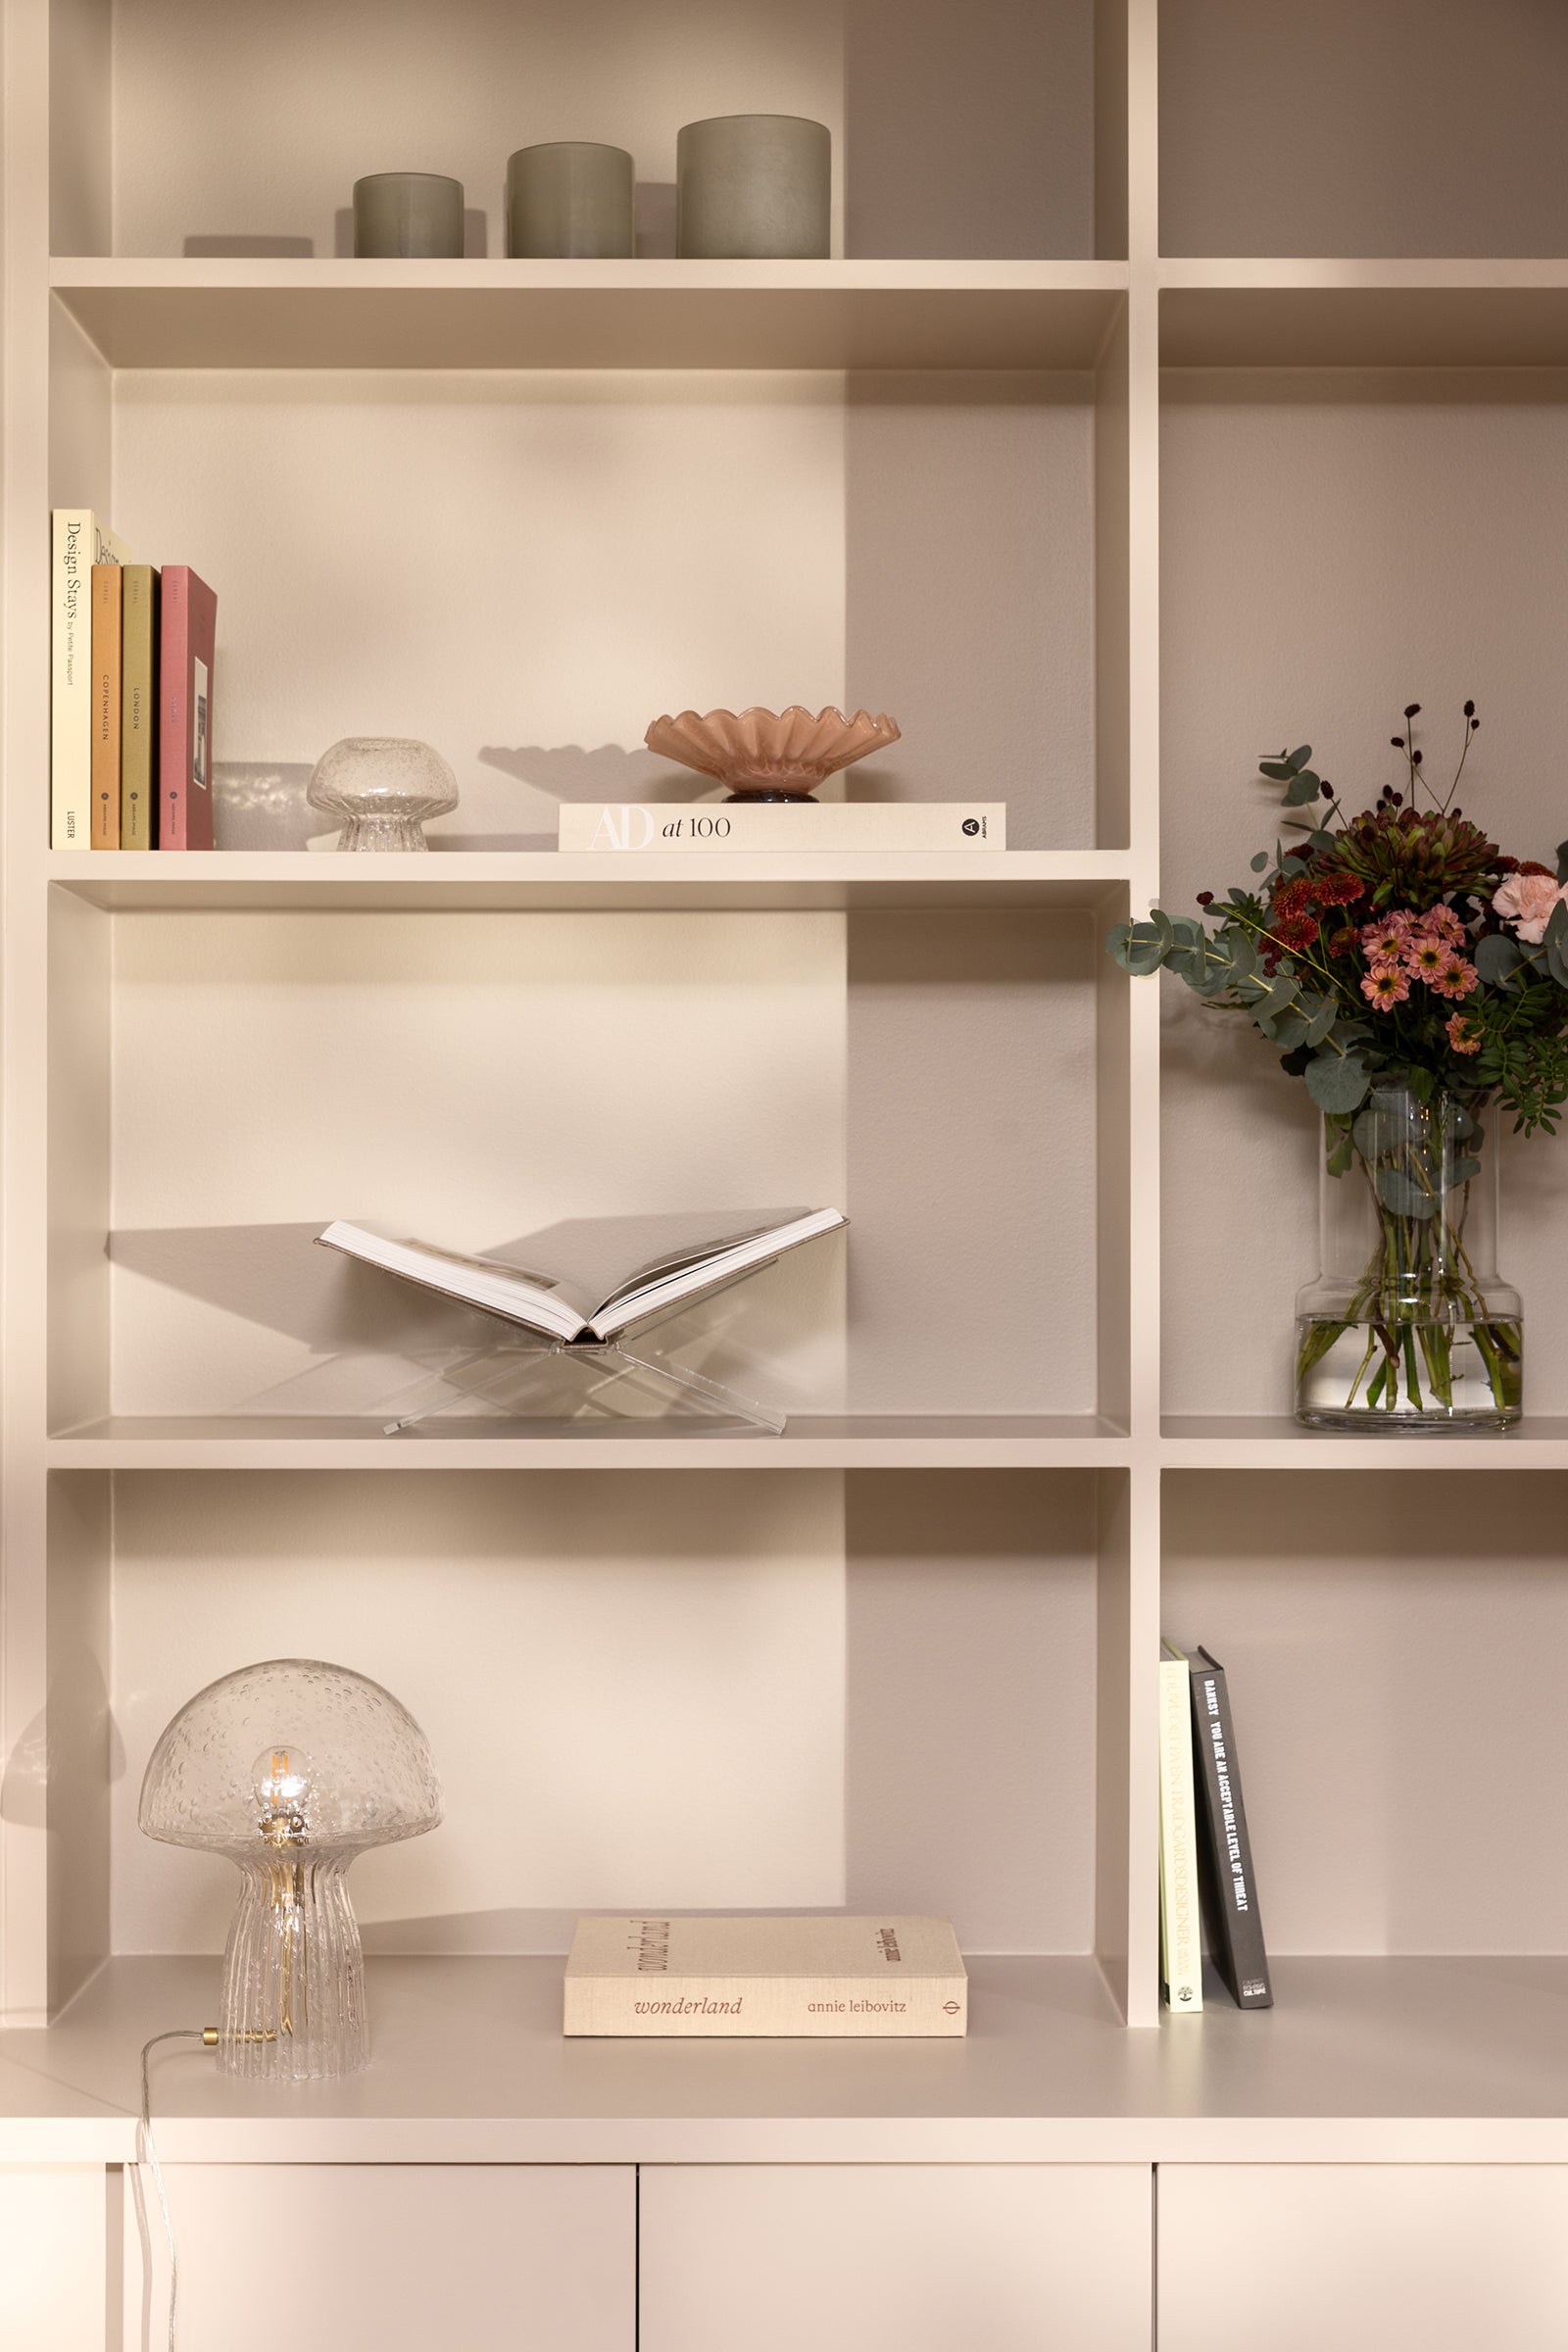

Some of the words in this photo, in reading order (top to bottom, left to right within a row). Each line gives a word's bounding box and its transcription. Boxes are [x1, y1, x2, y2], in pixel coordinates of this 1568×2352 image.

[64, 522, 81, 574] Design
[64, 579, 81, 618] Stays
[67, 621, 74, 630] by
[67, 810, 75, 839] LUSTER
[589, 806, 656, 850] AD
[662, 818, 685, 838] at
[690, 817, 731, 838] 100
[1204, 1679, 1219, 1715] BANKSY
[1210, 1721, 1222, 1740] YOU
[1213, 1741, 1226, 1759] ARE
[1216, 1761, 1228, 1774] AN
[1218, 1775, 1237, 1832] ACCEPTABLE
[1227, 1832, 1241, 1861] LEVEL
[1232, 1862, 1243, 1875] OF
[1234, 1876, 1248, 1911] THREAT
[627, 1920, 670, 1971] wonderland
[634, 1997, 743, 2015] wonderland
[808, 1999, 846, 2013] annie
[849, 1998, 906, 2013] leibovitz
